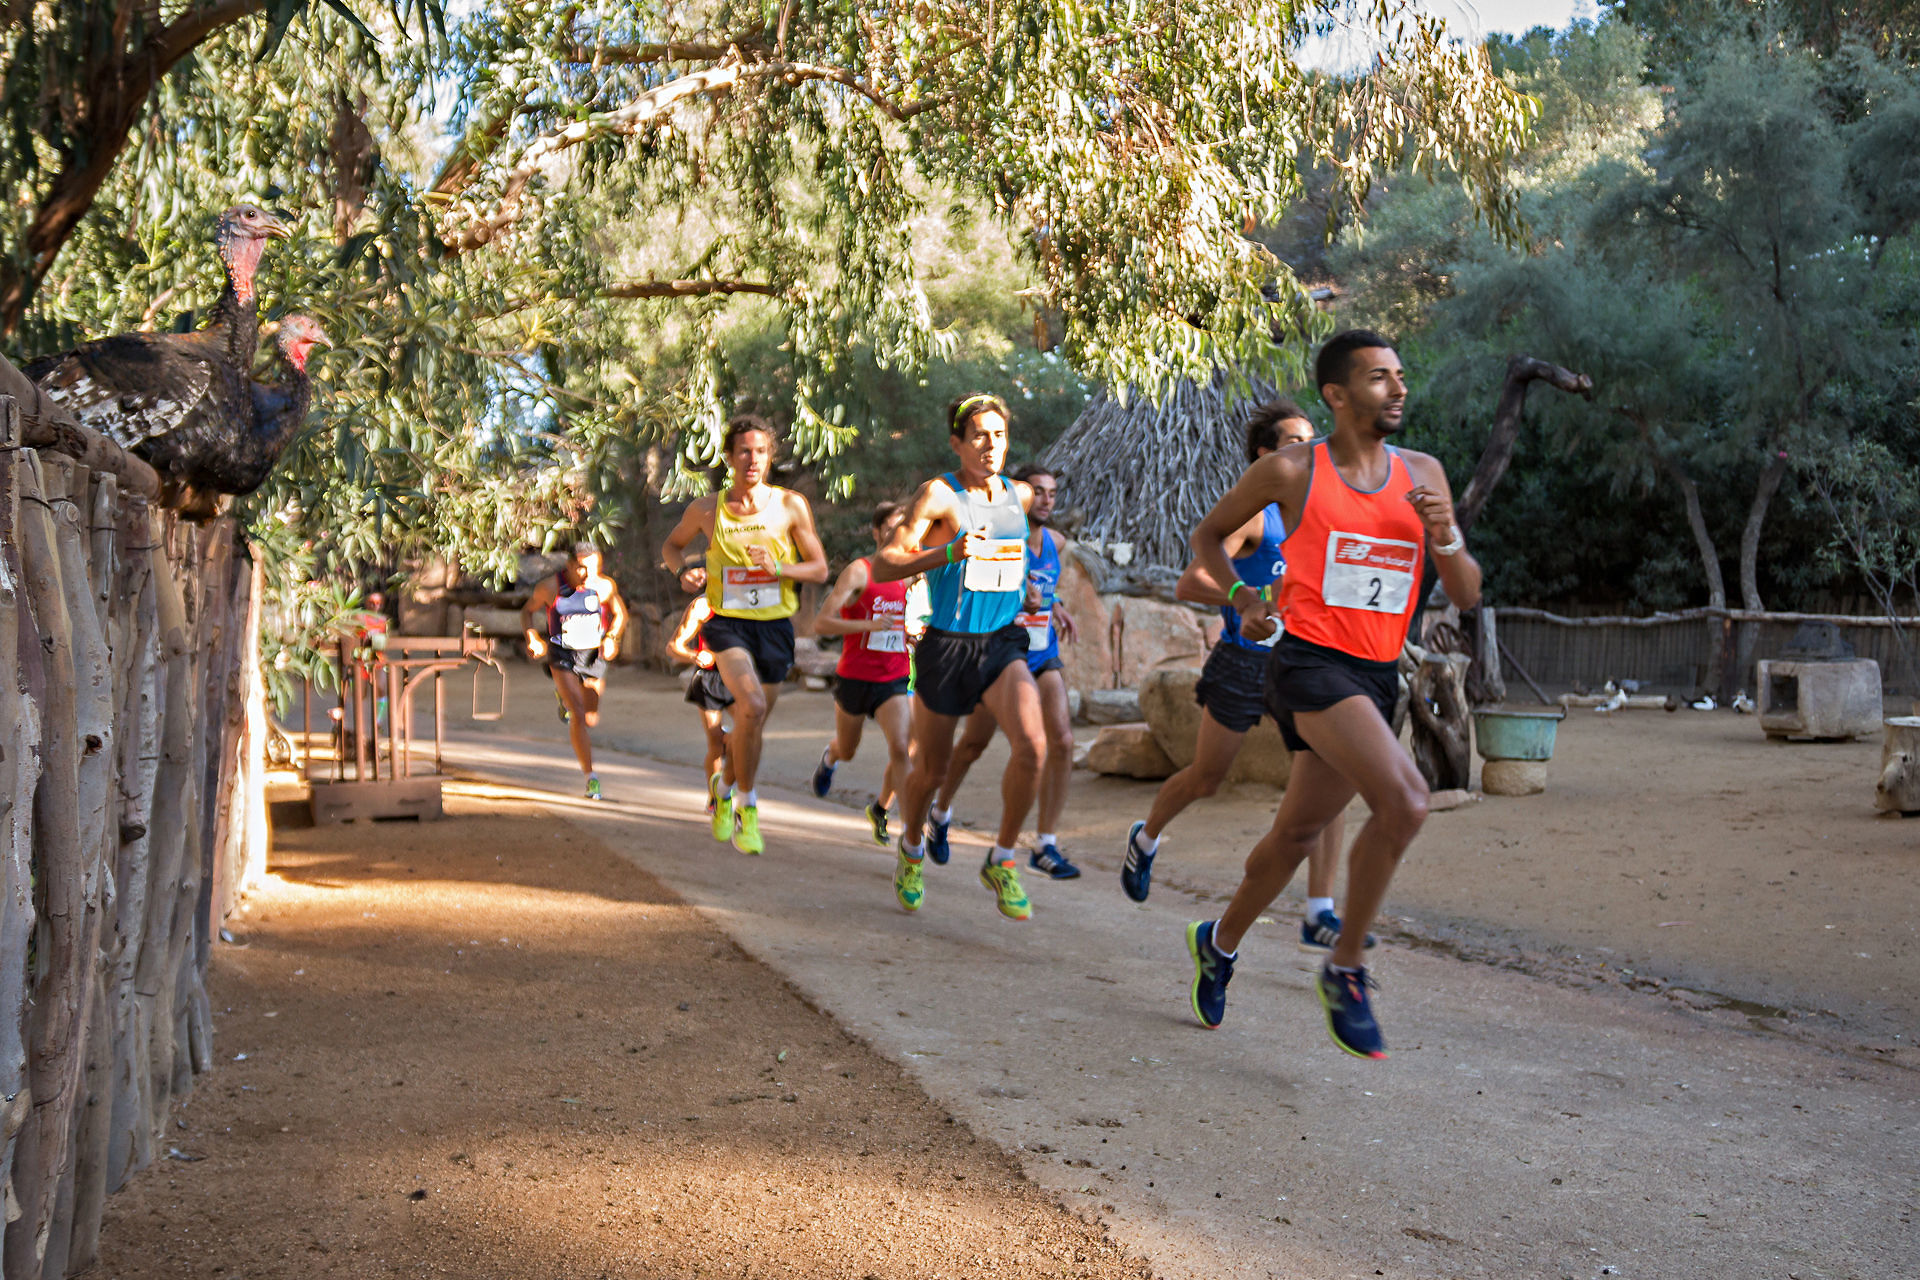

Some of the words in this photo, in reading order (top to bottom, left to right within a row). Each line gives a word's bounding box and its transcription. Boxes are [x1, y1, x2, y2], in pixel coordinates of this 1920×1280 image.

[750, 588, 759, 606] 3
[1366, 577, 1382, 606] 2
[885, 635, 897, 649] 12
